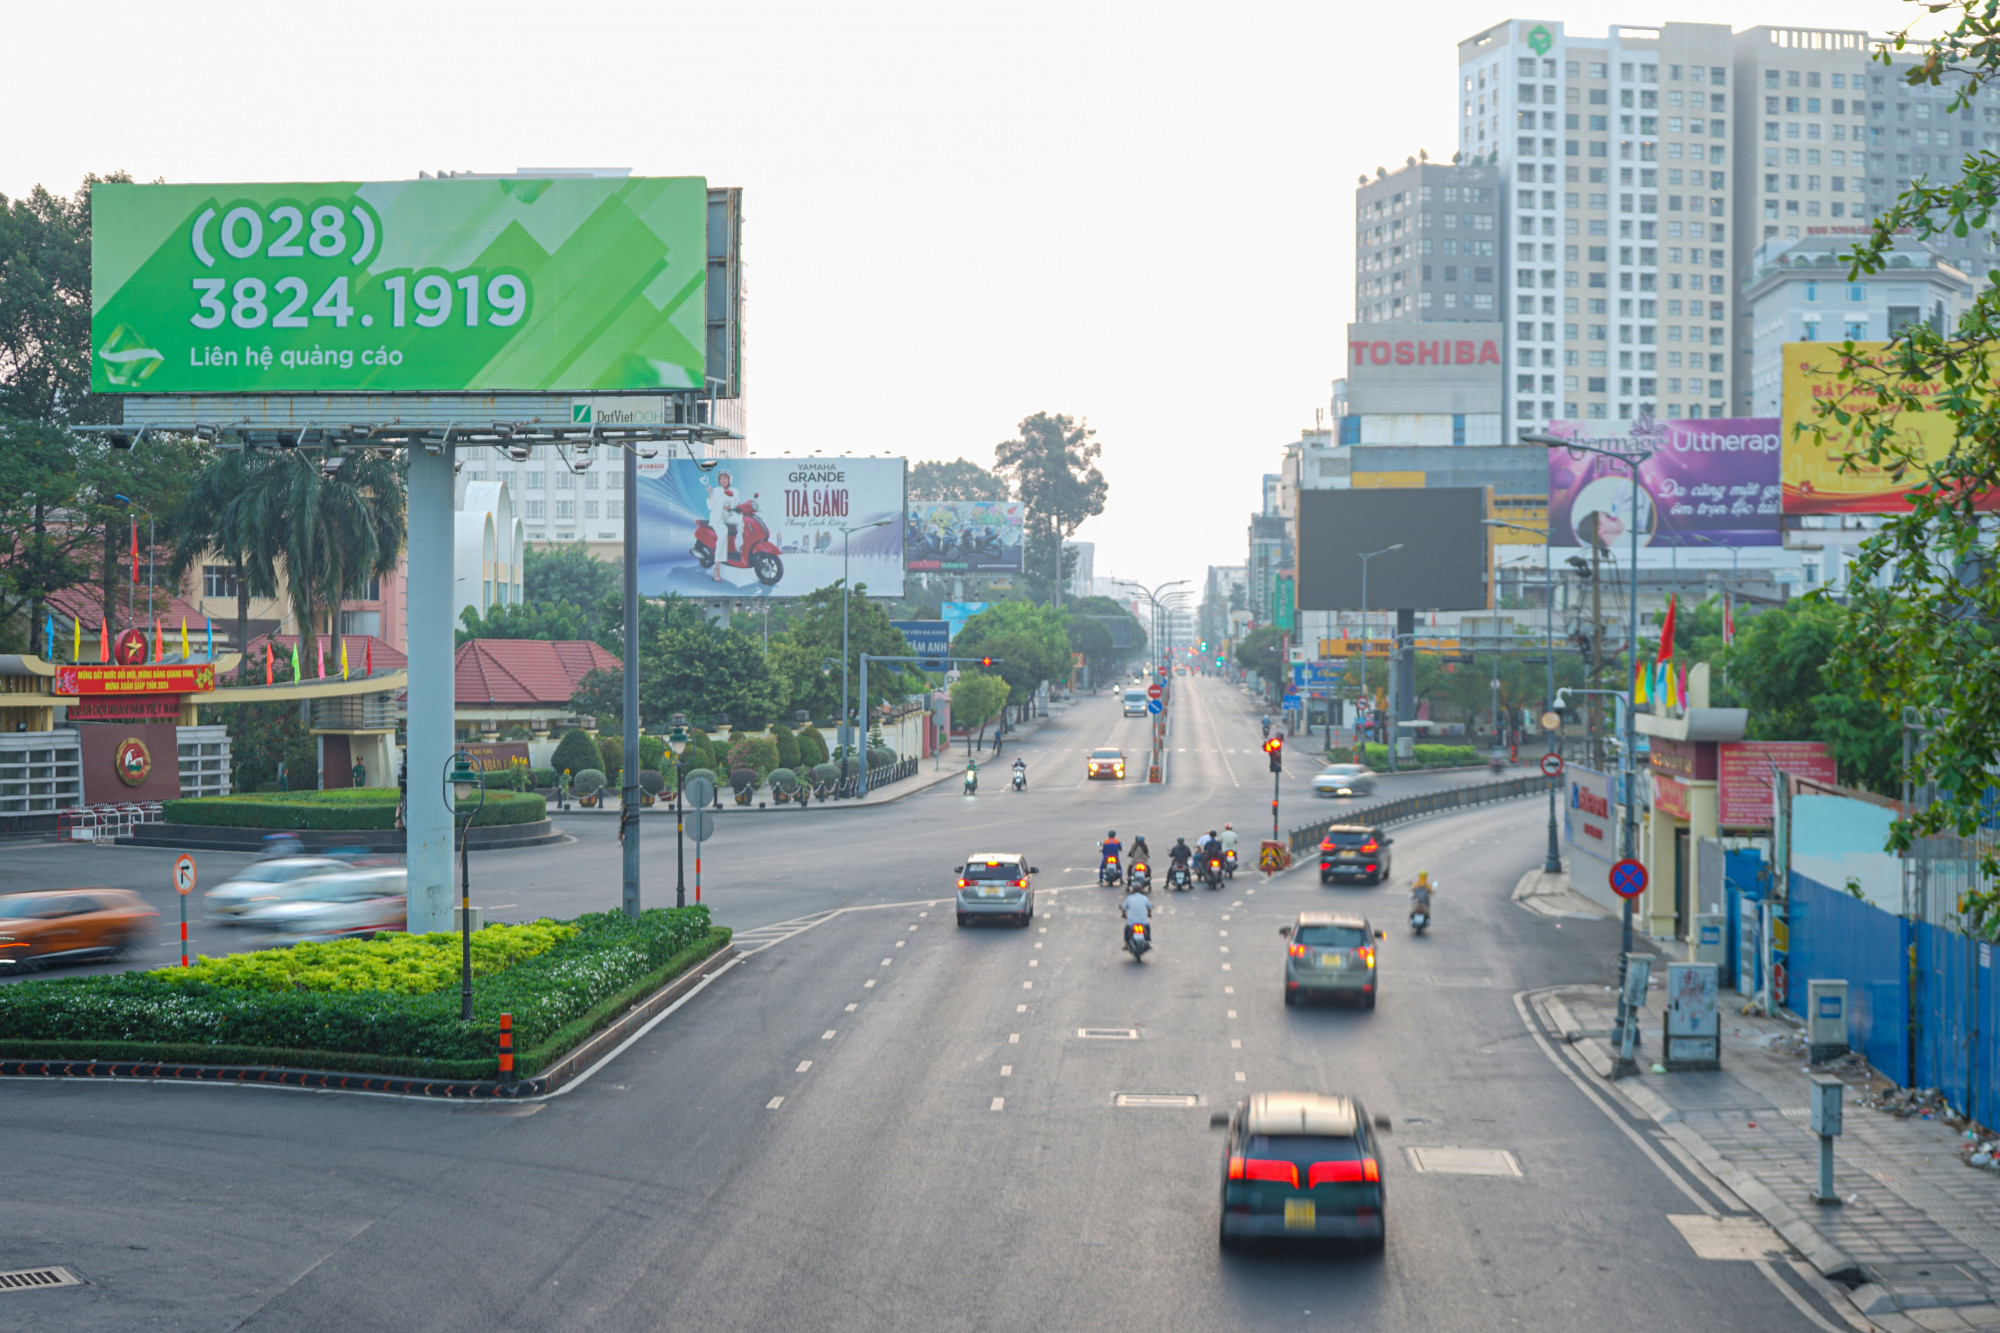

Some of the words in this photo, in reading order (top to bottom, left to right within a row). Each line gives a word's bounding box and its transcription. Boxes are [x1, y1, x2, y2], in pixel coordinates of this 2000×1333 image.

[190, 204, 377, 268] (028)
[189, 273, 528, 329] 3824.1919
[190, 346, 239, 367] Liên
[245, 346, 273, 371] hệ
[280, 343, 354, 372] quảng
[361, 346, 404, 367] cáo
[1348, 340, 1501, 365] TOSHIBA
[788, 471, 846, 483] GRANDE
[797, 463, 837, 471] YAMAHA
[784, 483, 810, 517] TOẢ
[813, 483, 849, 517] SÁNG
[927, 641, 947, 652] ANH
[120, 680, 133, 690] XUÂN
[158, 680, 169, 689] 2024
[71, 702, 92, 716] QUÂN
[94, 702, 107, 718] ĐỘI
[109, 701, 129, 716] NHÂN
[130, 701, 146, 715] DÂN
[147, 700, 162, 716] VIỆT
[163, 702, 179, 713] NAM
